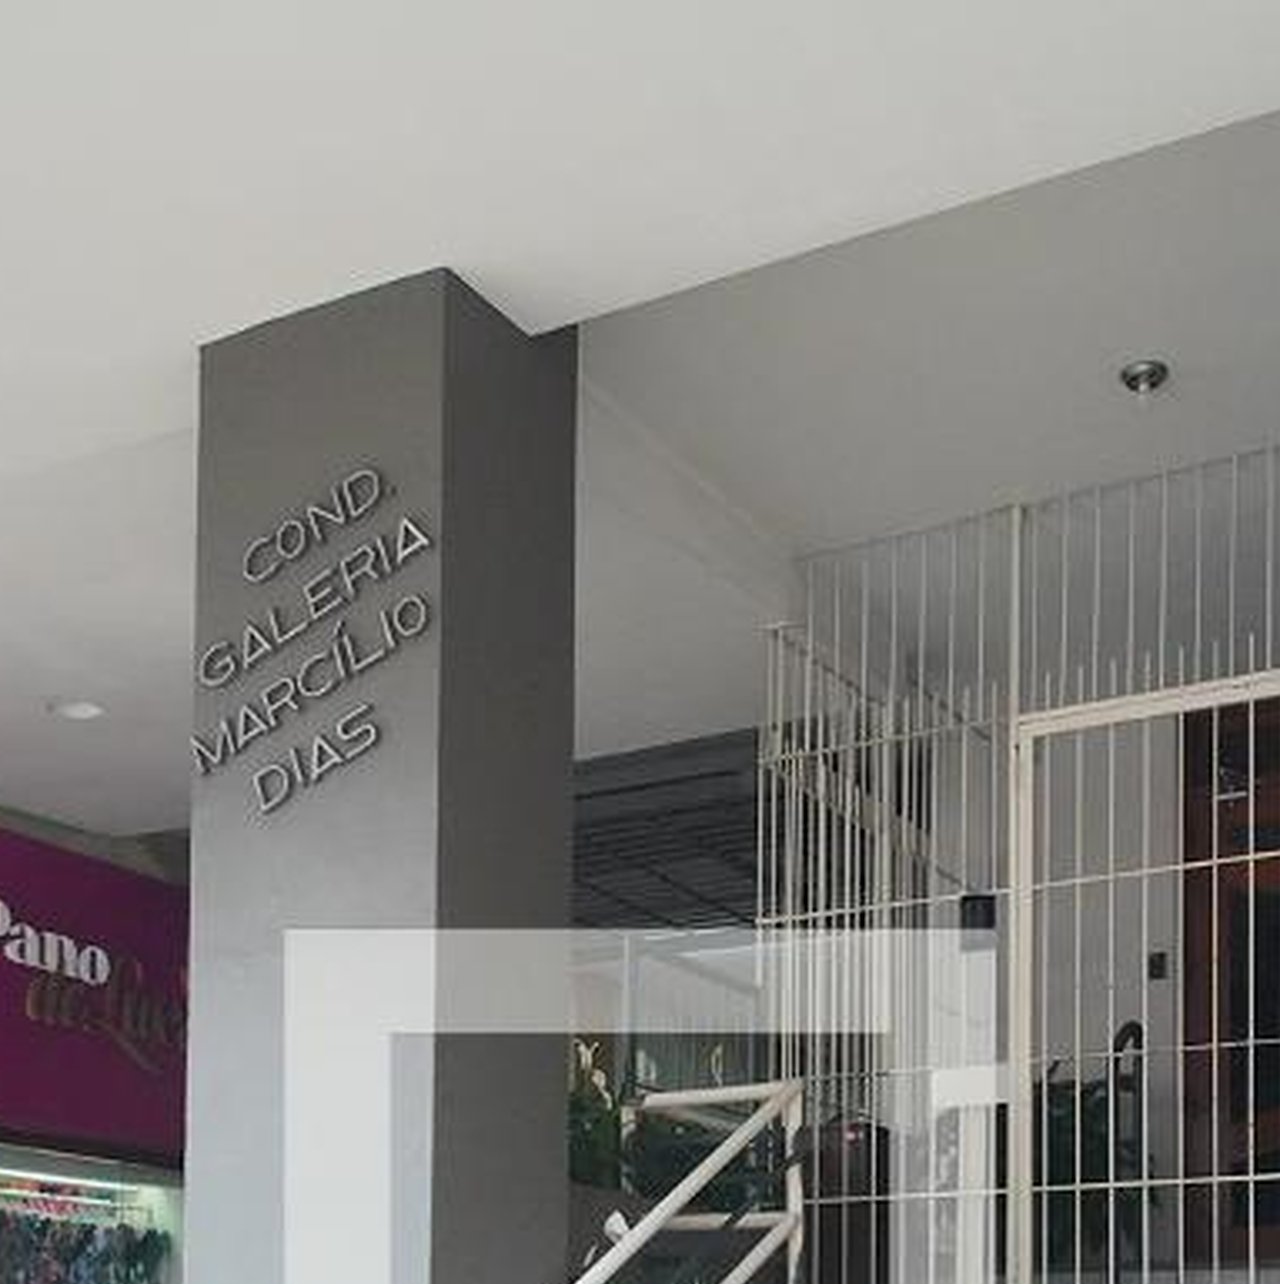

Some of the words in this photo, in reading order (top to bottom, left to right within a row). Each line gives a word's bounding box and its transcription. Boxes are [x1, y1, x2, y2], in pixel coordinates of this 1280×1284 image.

[241, 468, 399, 583] COND.
[198, 516, 432, 689] GALERIA
[189, 593, 429, 776] MARCÍLIO
[249, 701, 382, 813] DIAS
